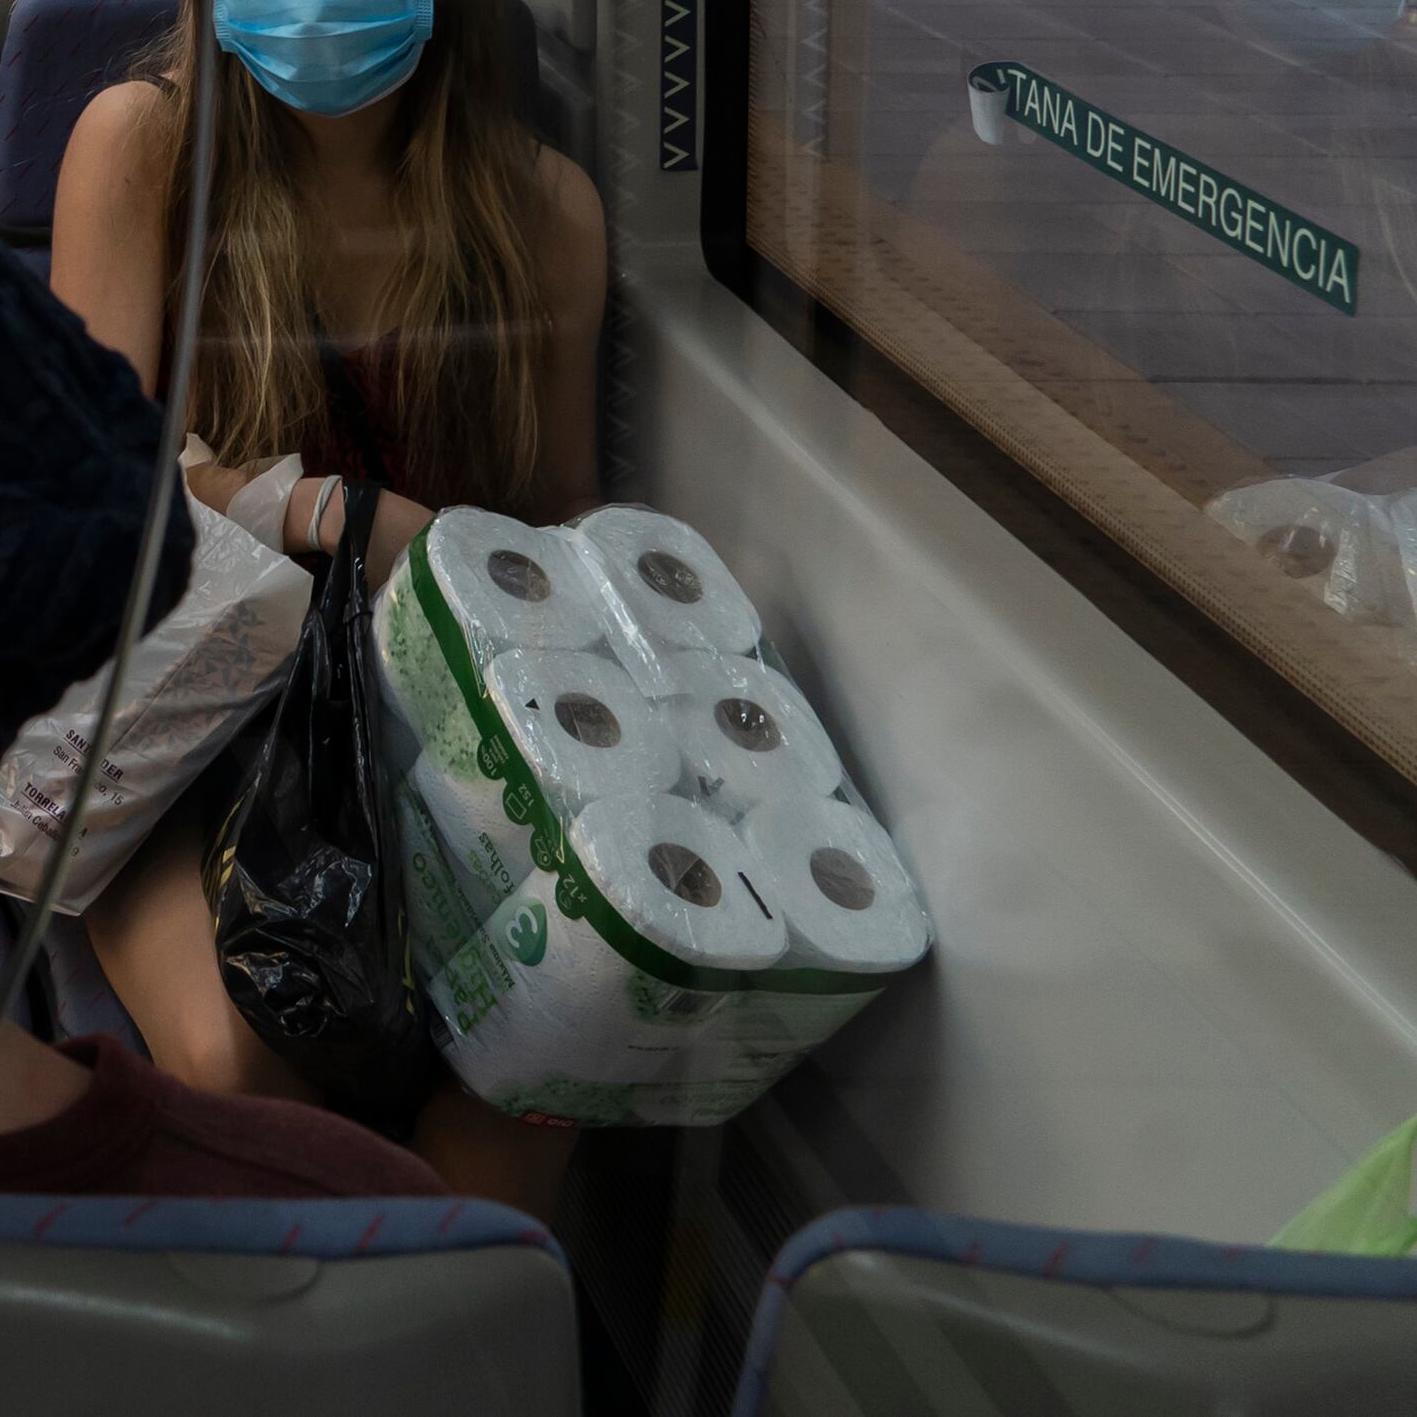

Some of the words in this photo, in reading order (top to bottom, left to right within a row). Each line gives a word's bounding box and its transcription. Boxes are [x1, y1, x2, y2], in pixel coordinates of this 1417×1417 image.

[998, 69, 1078, 146] TANA
[1086, 111, 1124, 173] DE
[1133, 137, 1351, 304] EMERGENCIA
[53, 745, 70, 764] San
[110, 791, 124, 806] 15
[65, 729, 124, 781] SANTDER
[24, 782, 88, 839] TORRELAA
[479, 832, 515, 895] folhas
[505, 905, 538, 949] 3
